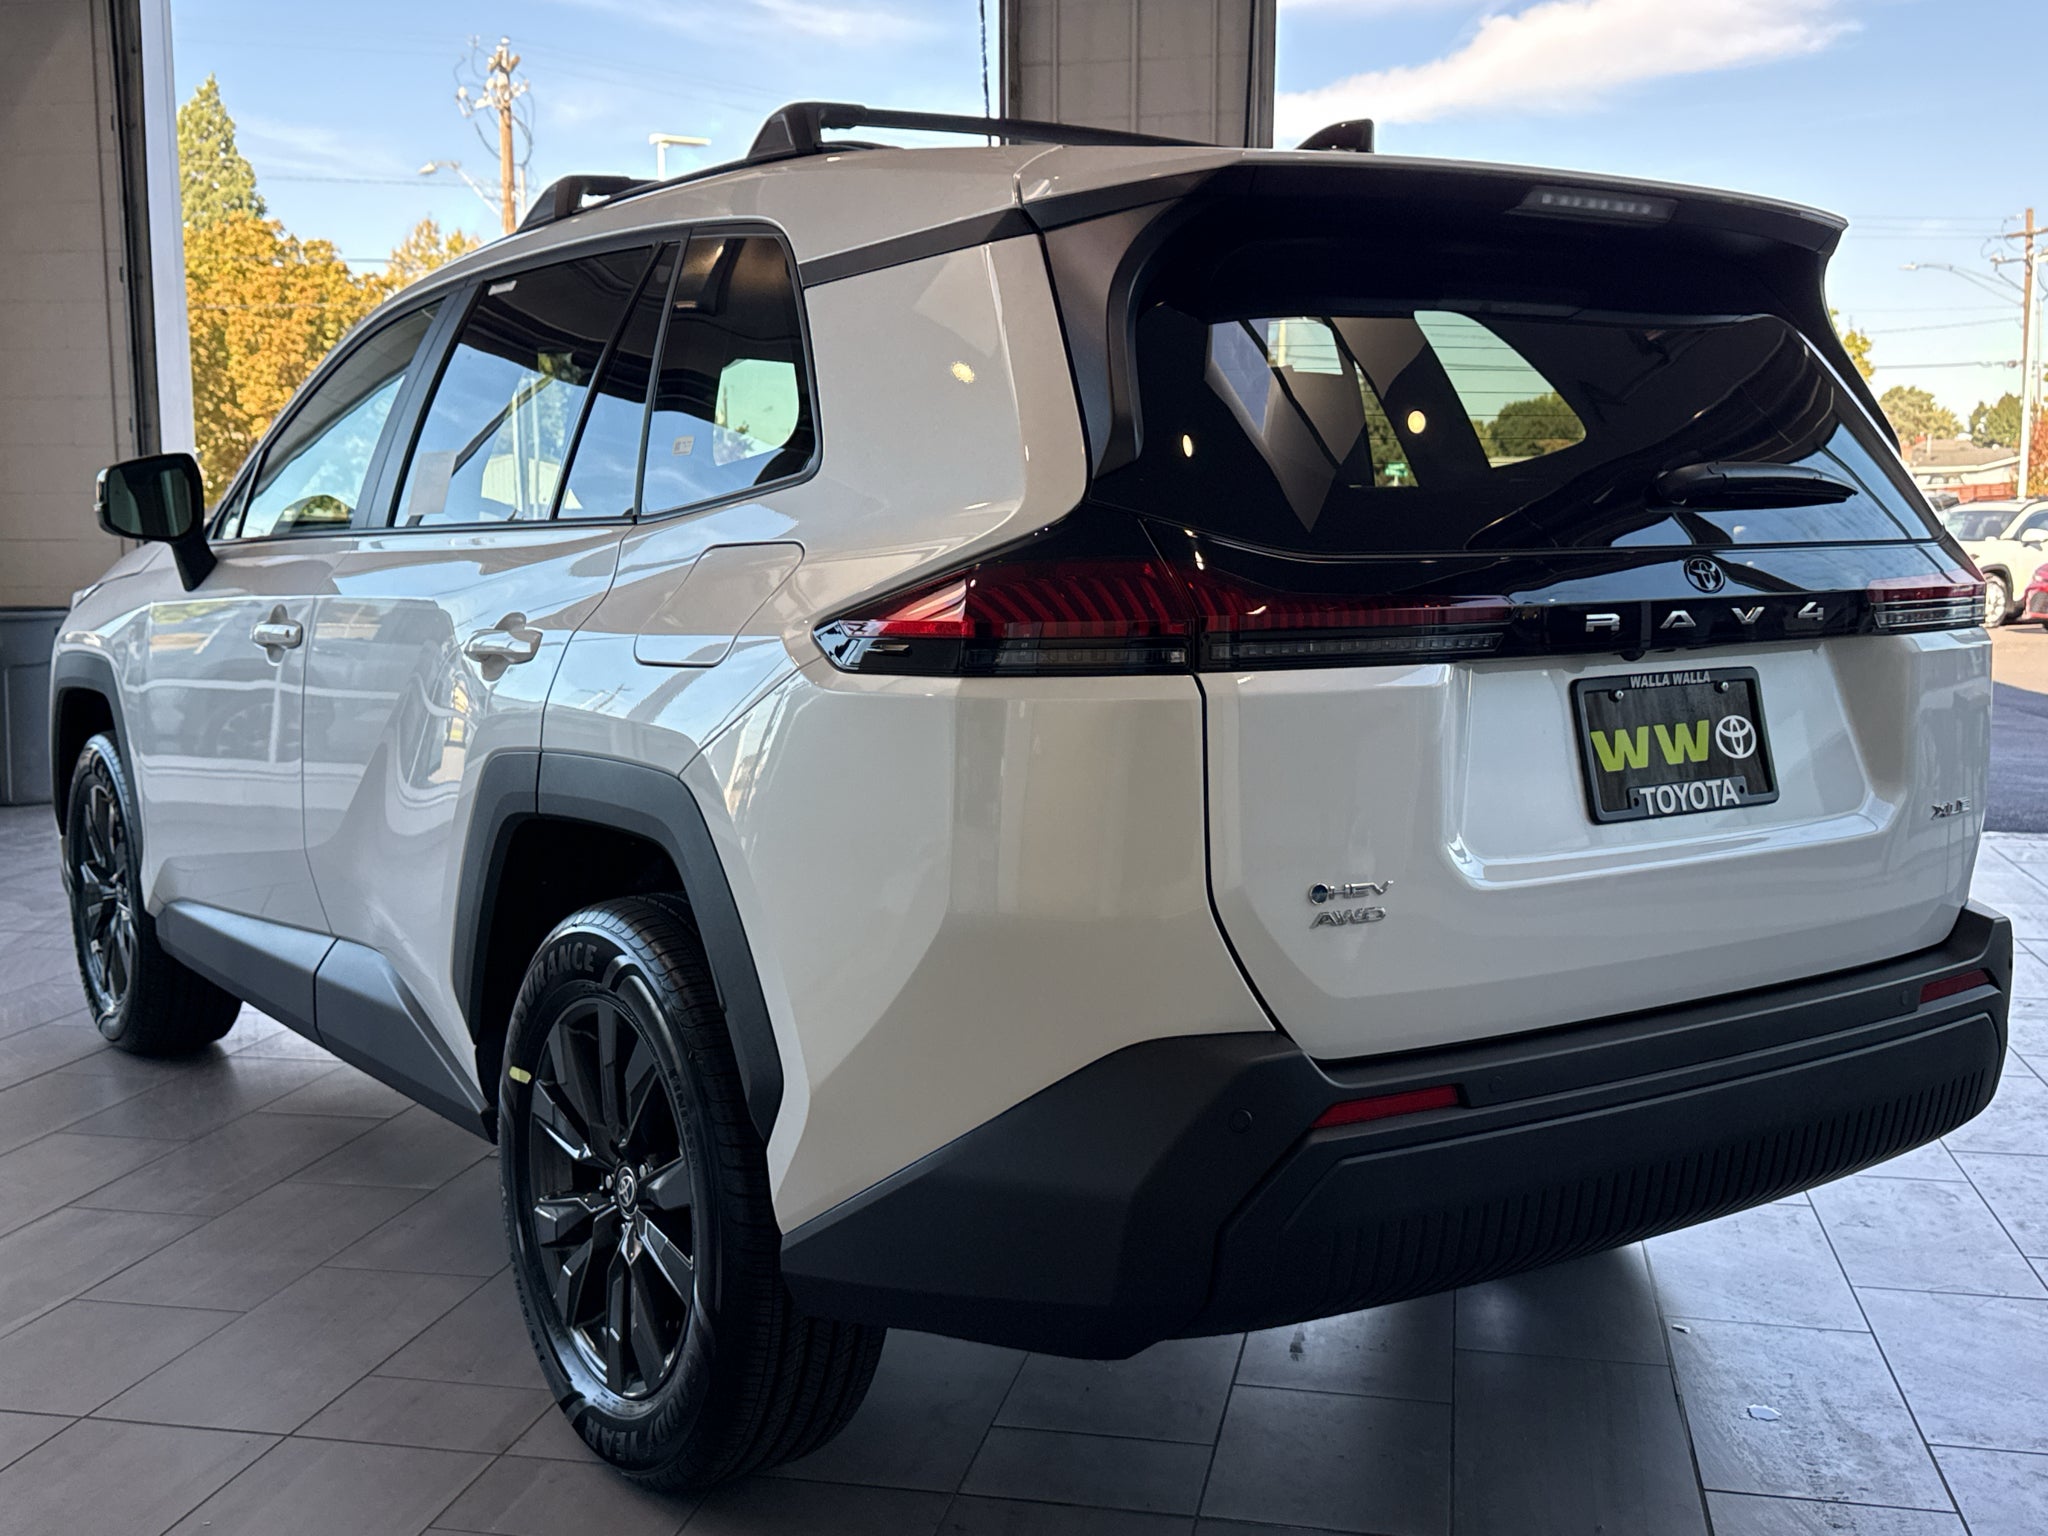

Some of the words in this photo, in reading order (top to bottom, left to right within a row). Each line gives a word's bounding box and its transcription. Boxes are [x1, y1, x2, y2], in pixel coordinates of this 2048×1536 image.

[1585, 601, 1825, 632] RAV4
[1630, 674, 1670, 689] WALLA
[1672, 670, 1711, 686] WALLA
[1590, 719, 1710, 772] WW
[1639, 778, 1741, 815] TOYOTA
[1328, 880, 1394, 900] HEV
[1309, 906, 1386, 929] AWD
